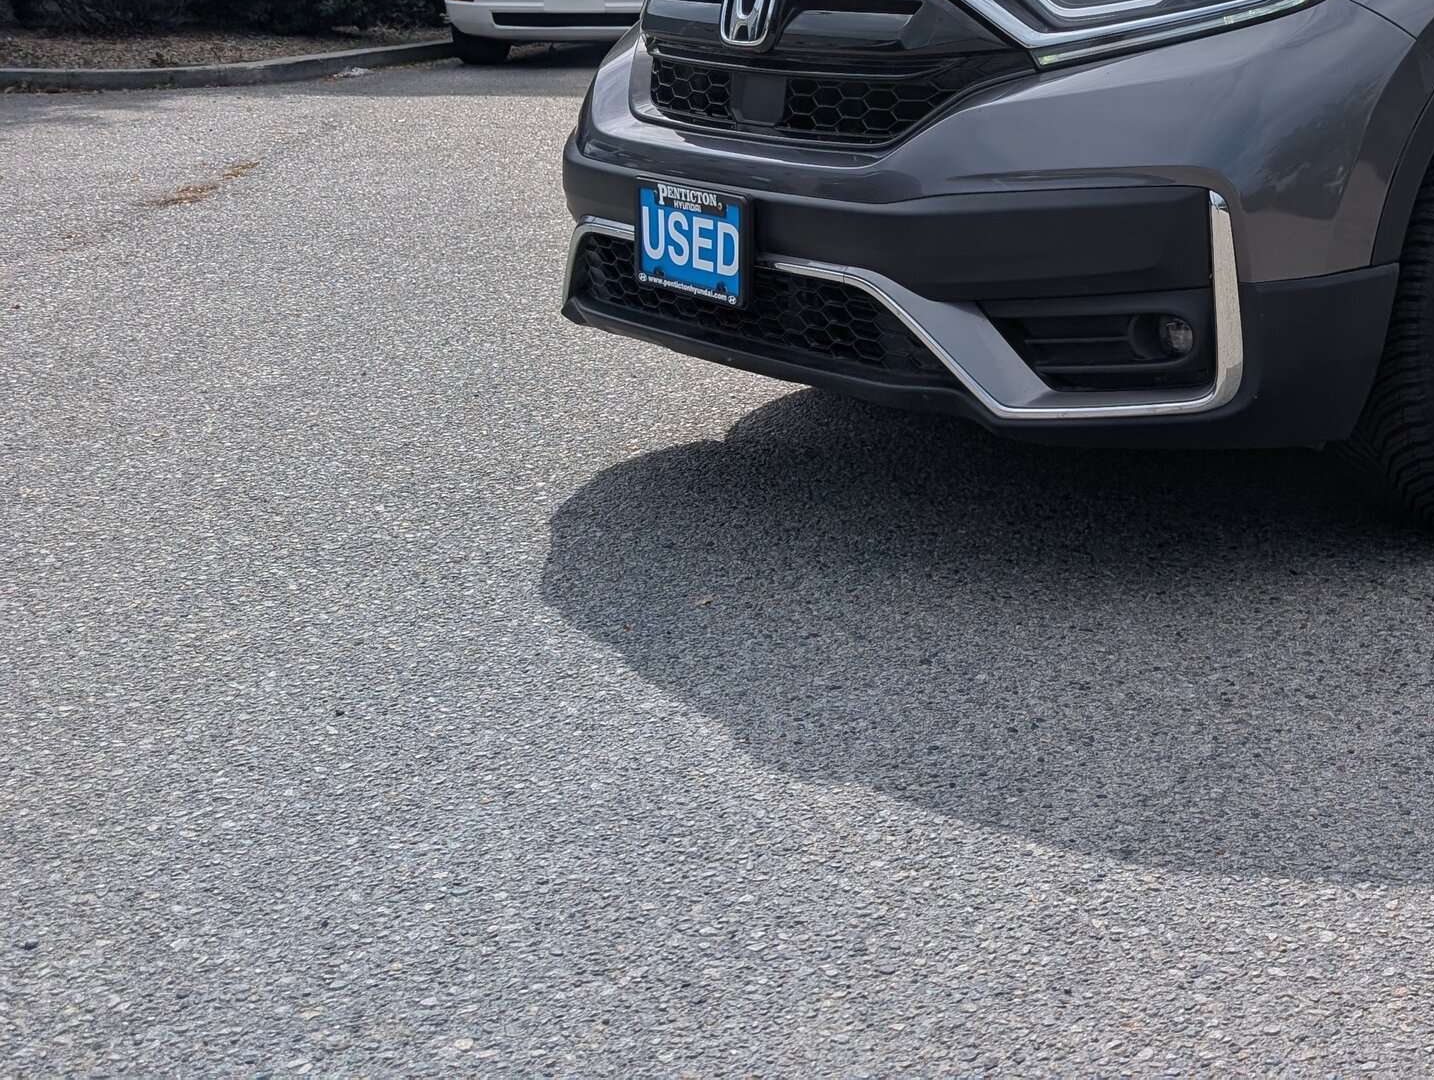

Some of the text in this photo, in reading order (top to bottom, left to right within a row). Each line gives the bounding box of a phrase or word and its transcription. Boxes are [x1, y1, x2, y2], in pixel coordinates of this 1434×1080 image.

[657, 183, 718, 208] PENTICTON
[673, 200, 702, 213] HYUNDAI
[642, 205, 739, 277] USED
[647, 276, 727, 301] www.pentictonhyundai.com
